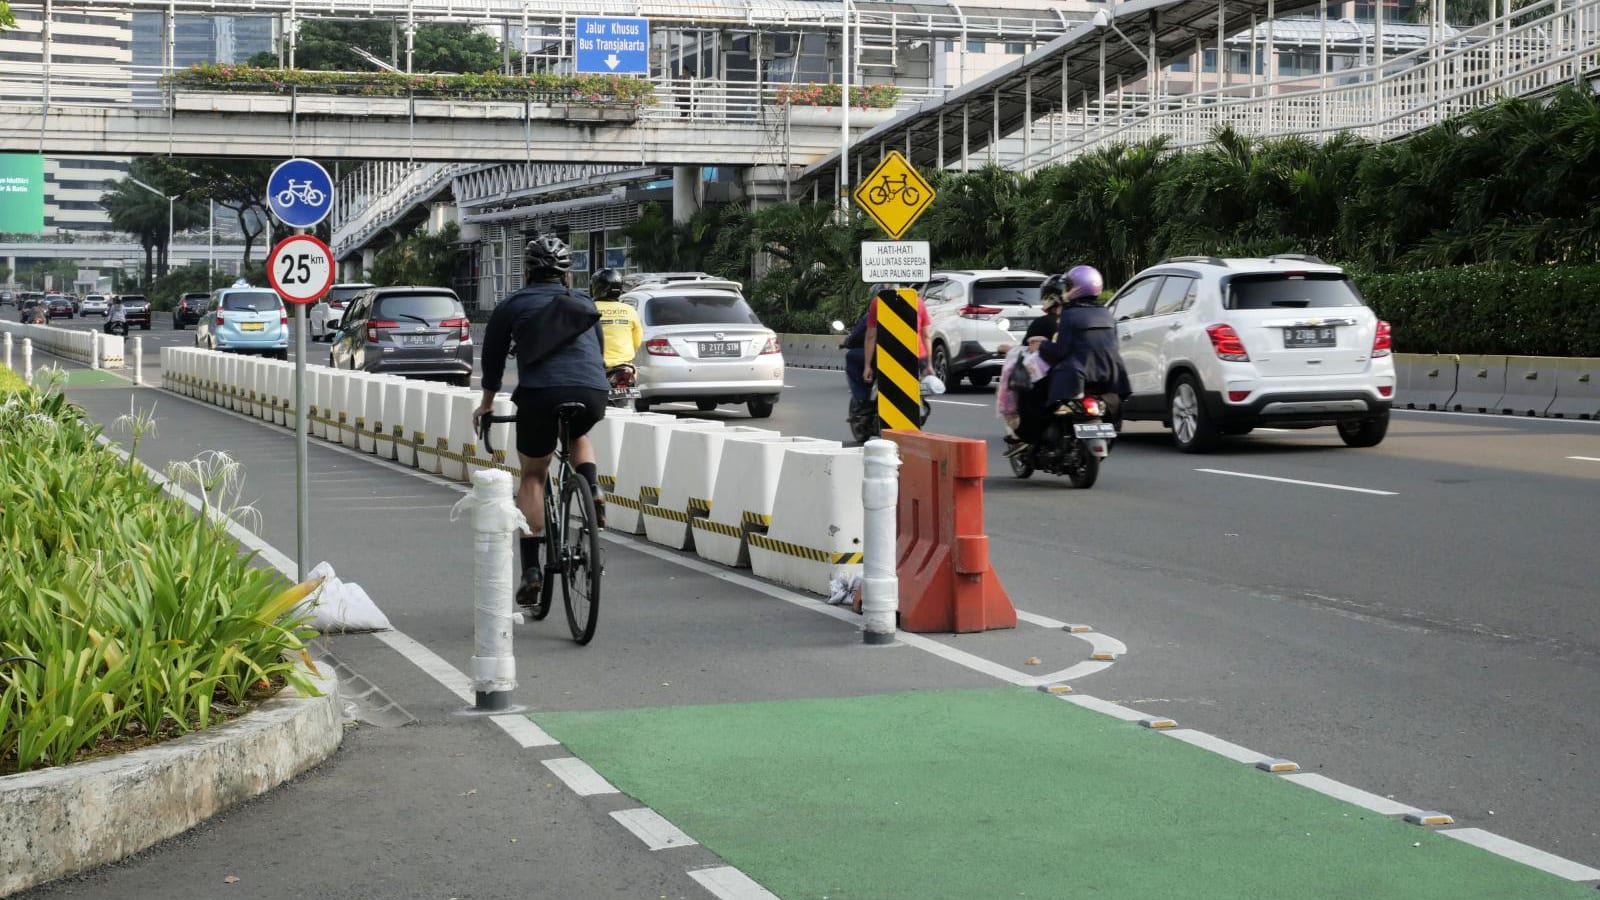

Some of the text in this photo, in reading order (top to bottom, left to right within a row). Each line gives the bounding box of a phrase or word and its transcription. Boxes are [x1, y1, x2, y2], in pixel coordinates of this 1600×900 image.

[586, 22, 639, 35] Jalur Khusus
[579, 38, 645, 54] Bus Transjakarta
[877, 245, 913, 255] HATI-HATI
[865, 257, 927, 266] LALU LINTAS SEPEDA
[281, 254, 324, 284] 25 km
[869, 269, 924, 278] JALUR PALING KIRI
[701, 343, 706, 352] B
